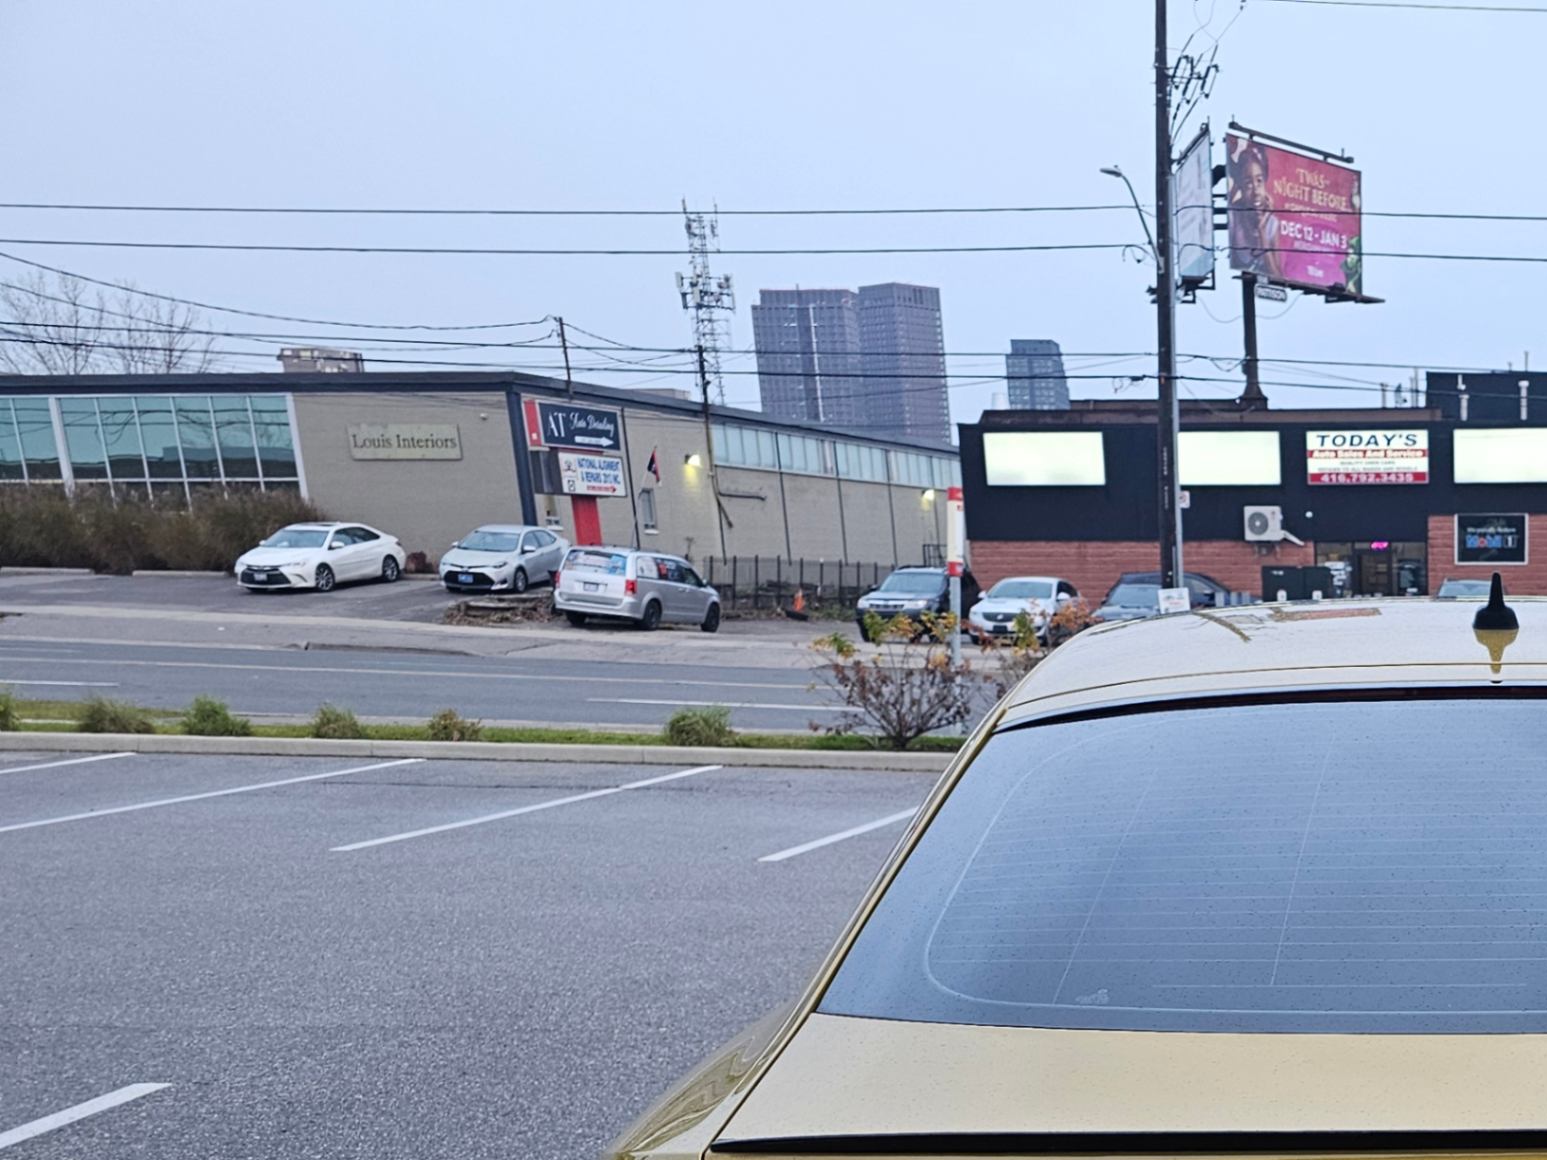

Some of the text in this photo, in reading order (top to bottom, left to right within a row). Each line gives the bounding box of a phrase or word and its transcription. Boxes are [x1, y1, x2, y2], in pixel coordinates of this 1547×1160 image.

[1273, 176, 1310, 202] NIGHT
[1279, 220, 1303, 239] DEC
[1303, 226, 1314, 242] 12
[1320, 230, 1341, 246] JAN
[1341, 235, 1348, 249] 3
[547, 411, 567, 437] AT
[352, 433, 457, 449] Louis Interiors
[1316, 433, 1417, 447] TODAY'S
[1312, 449, 1424, 459] Auto Sales And Service
